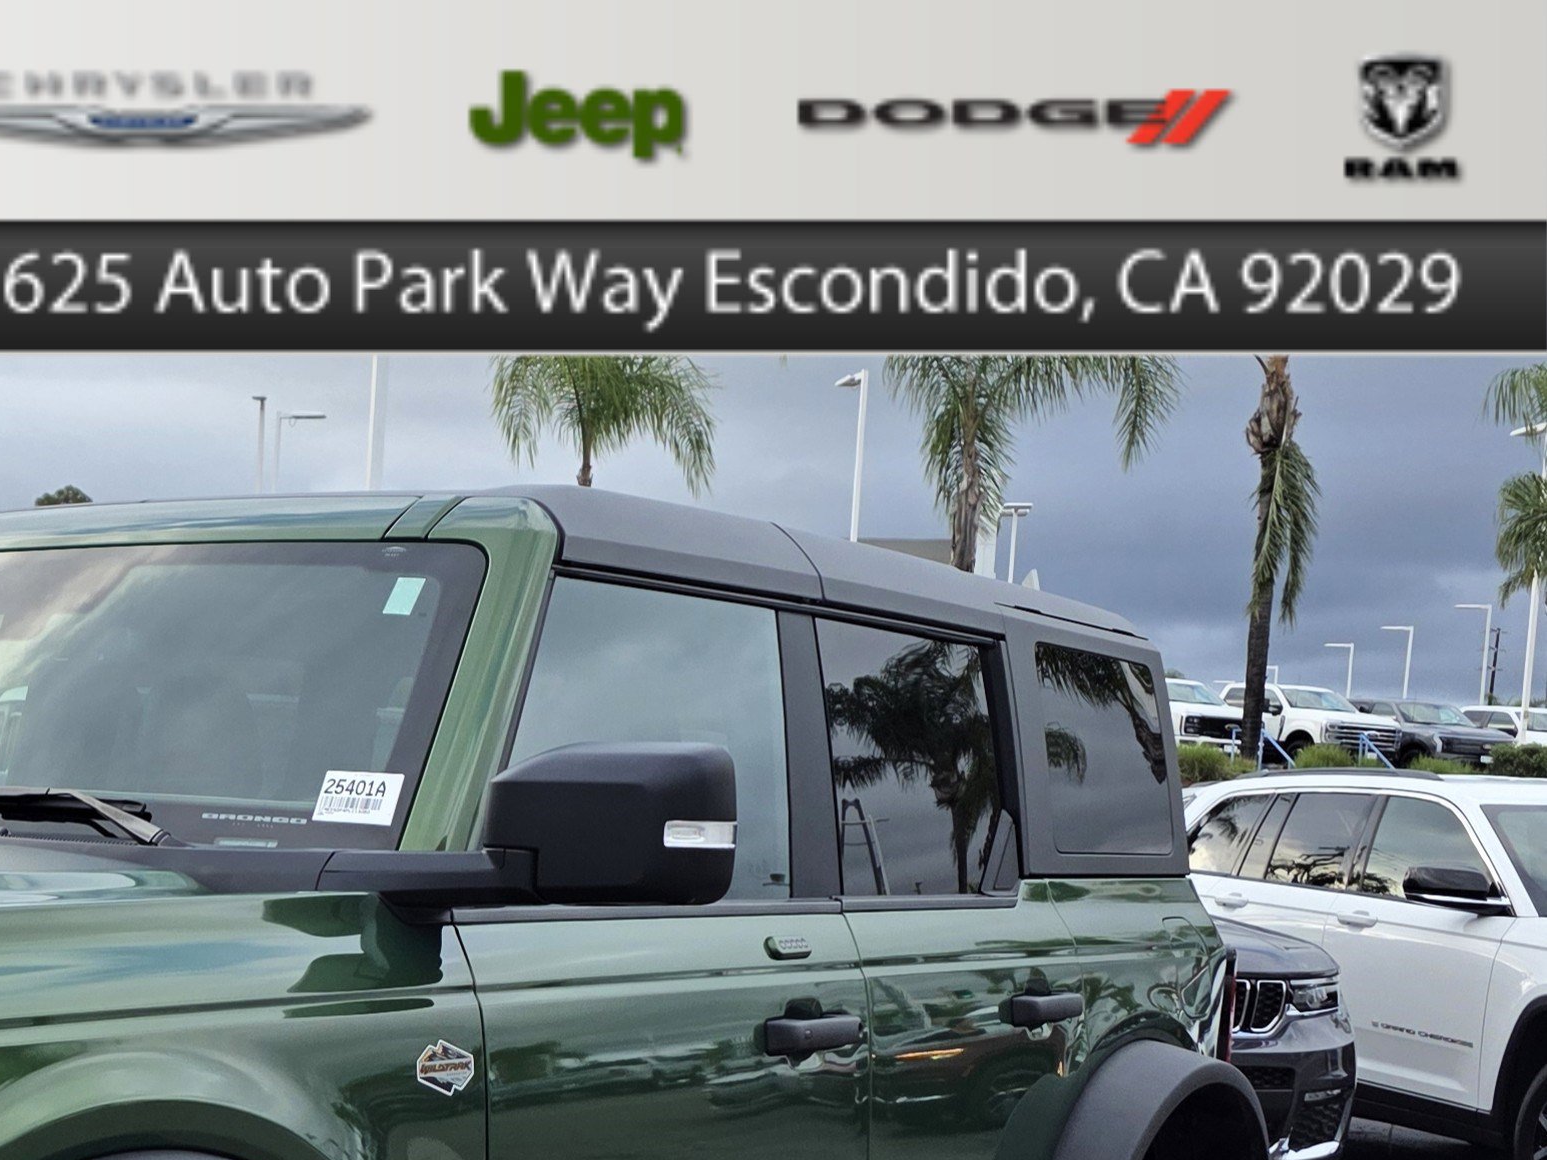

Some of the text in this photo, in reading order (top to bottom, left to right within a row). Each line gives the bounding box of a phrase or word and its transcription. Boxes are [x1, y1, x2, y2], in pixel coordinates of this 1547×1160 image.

[324, 778, 387, 797] 25401A
[201, 812, 308, 825] BRONCO
[420, 1061, 472, 1076] WILDTRAK
